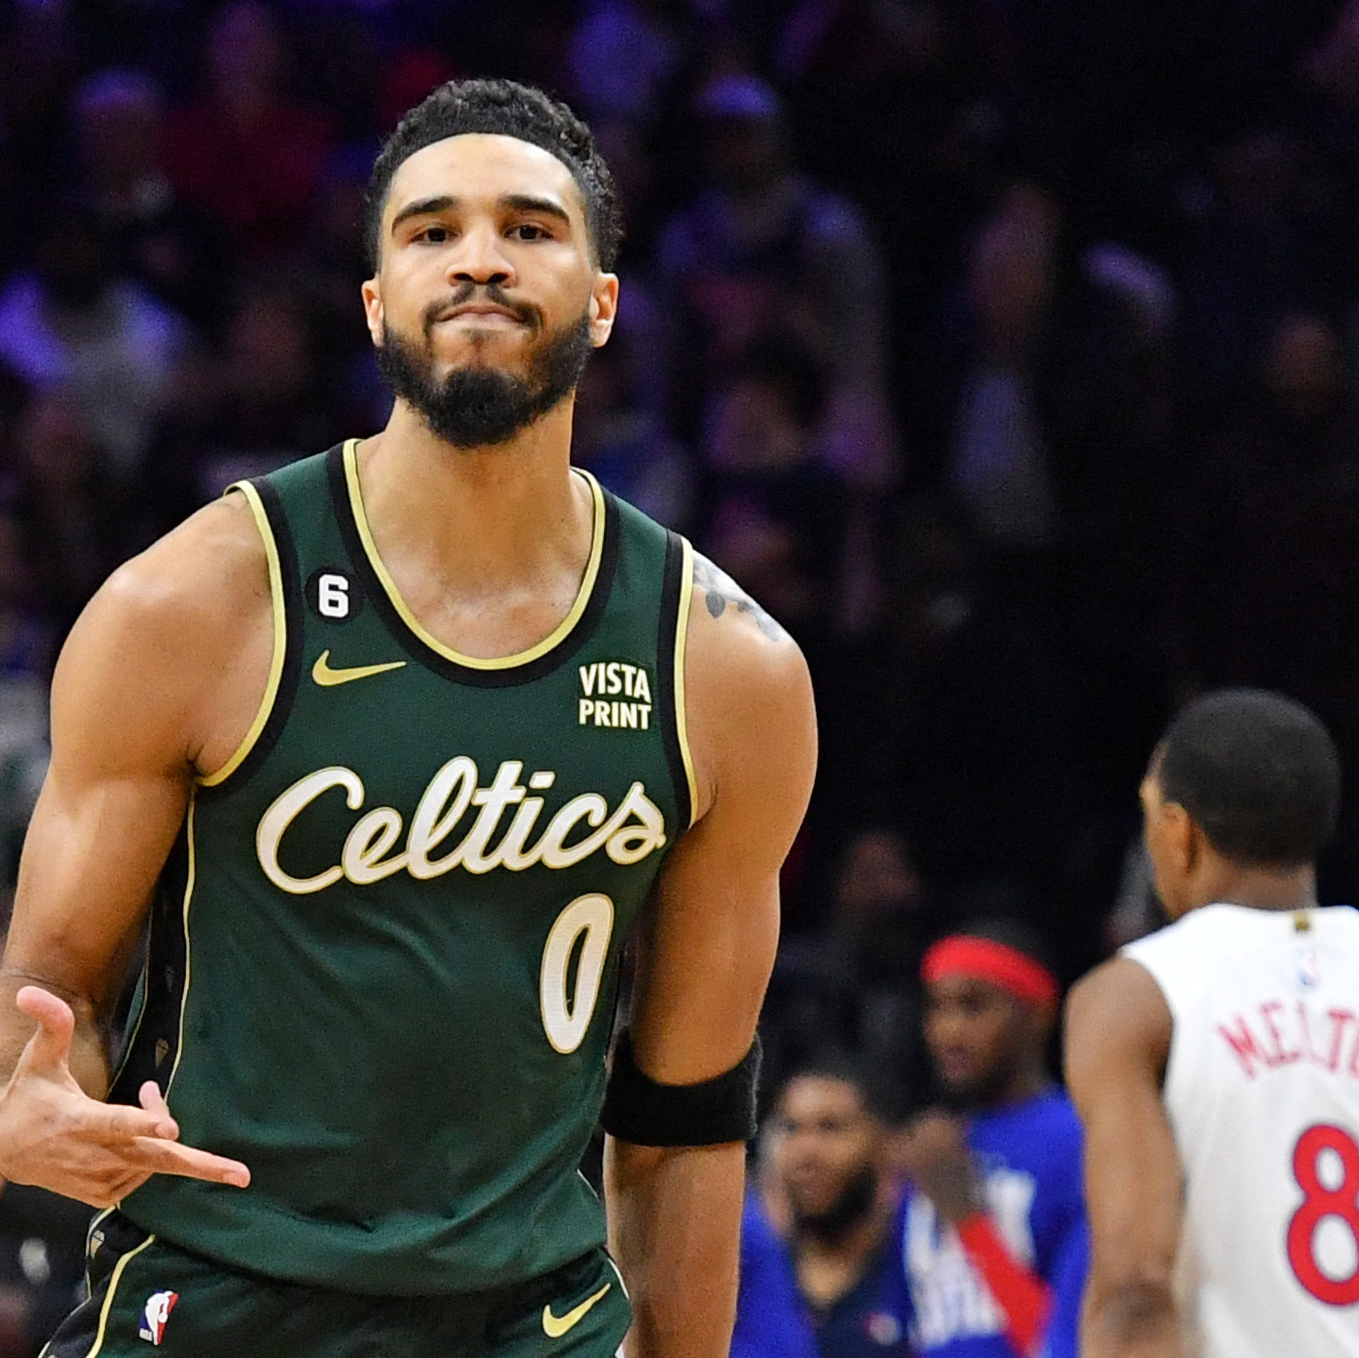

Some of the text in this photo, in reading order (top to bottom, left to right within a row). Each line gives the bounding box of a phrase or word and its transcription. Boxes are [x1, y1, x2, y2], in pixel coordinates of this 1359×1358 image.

[318, 574, 349, 618] 6
[578, 662, 651, 702] VISTA
[578, 699, 652, 730] PRINT
[256, 755, 667, 894] Celtics
[540, 892, 615, 1054] 0
